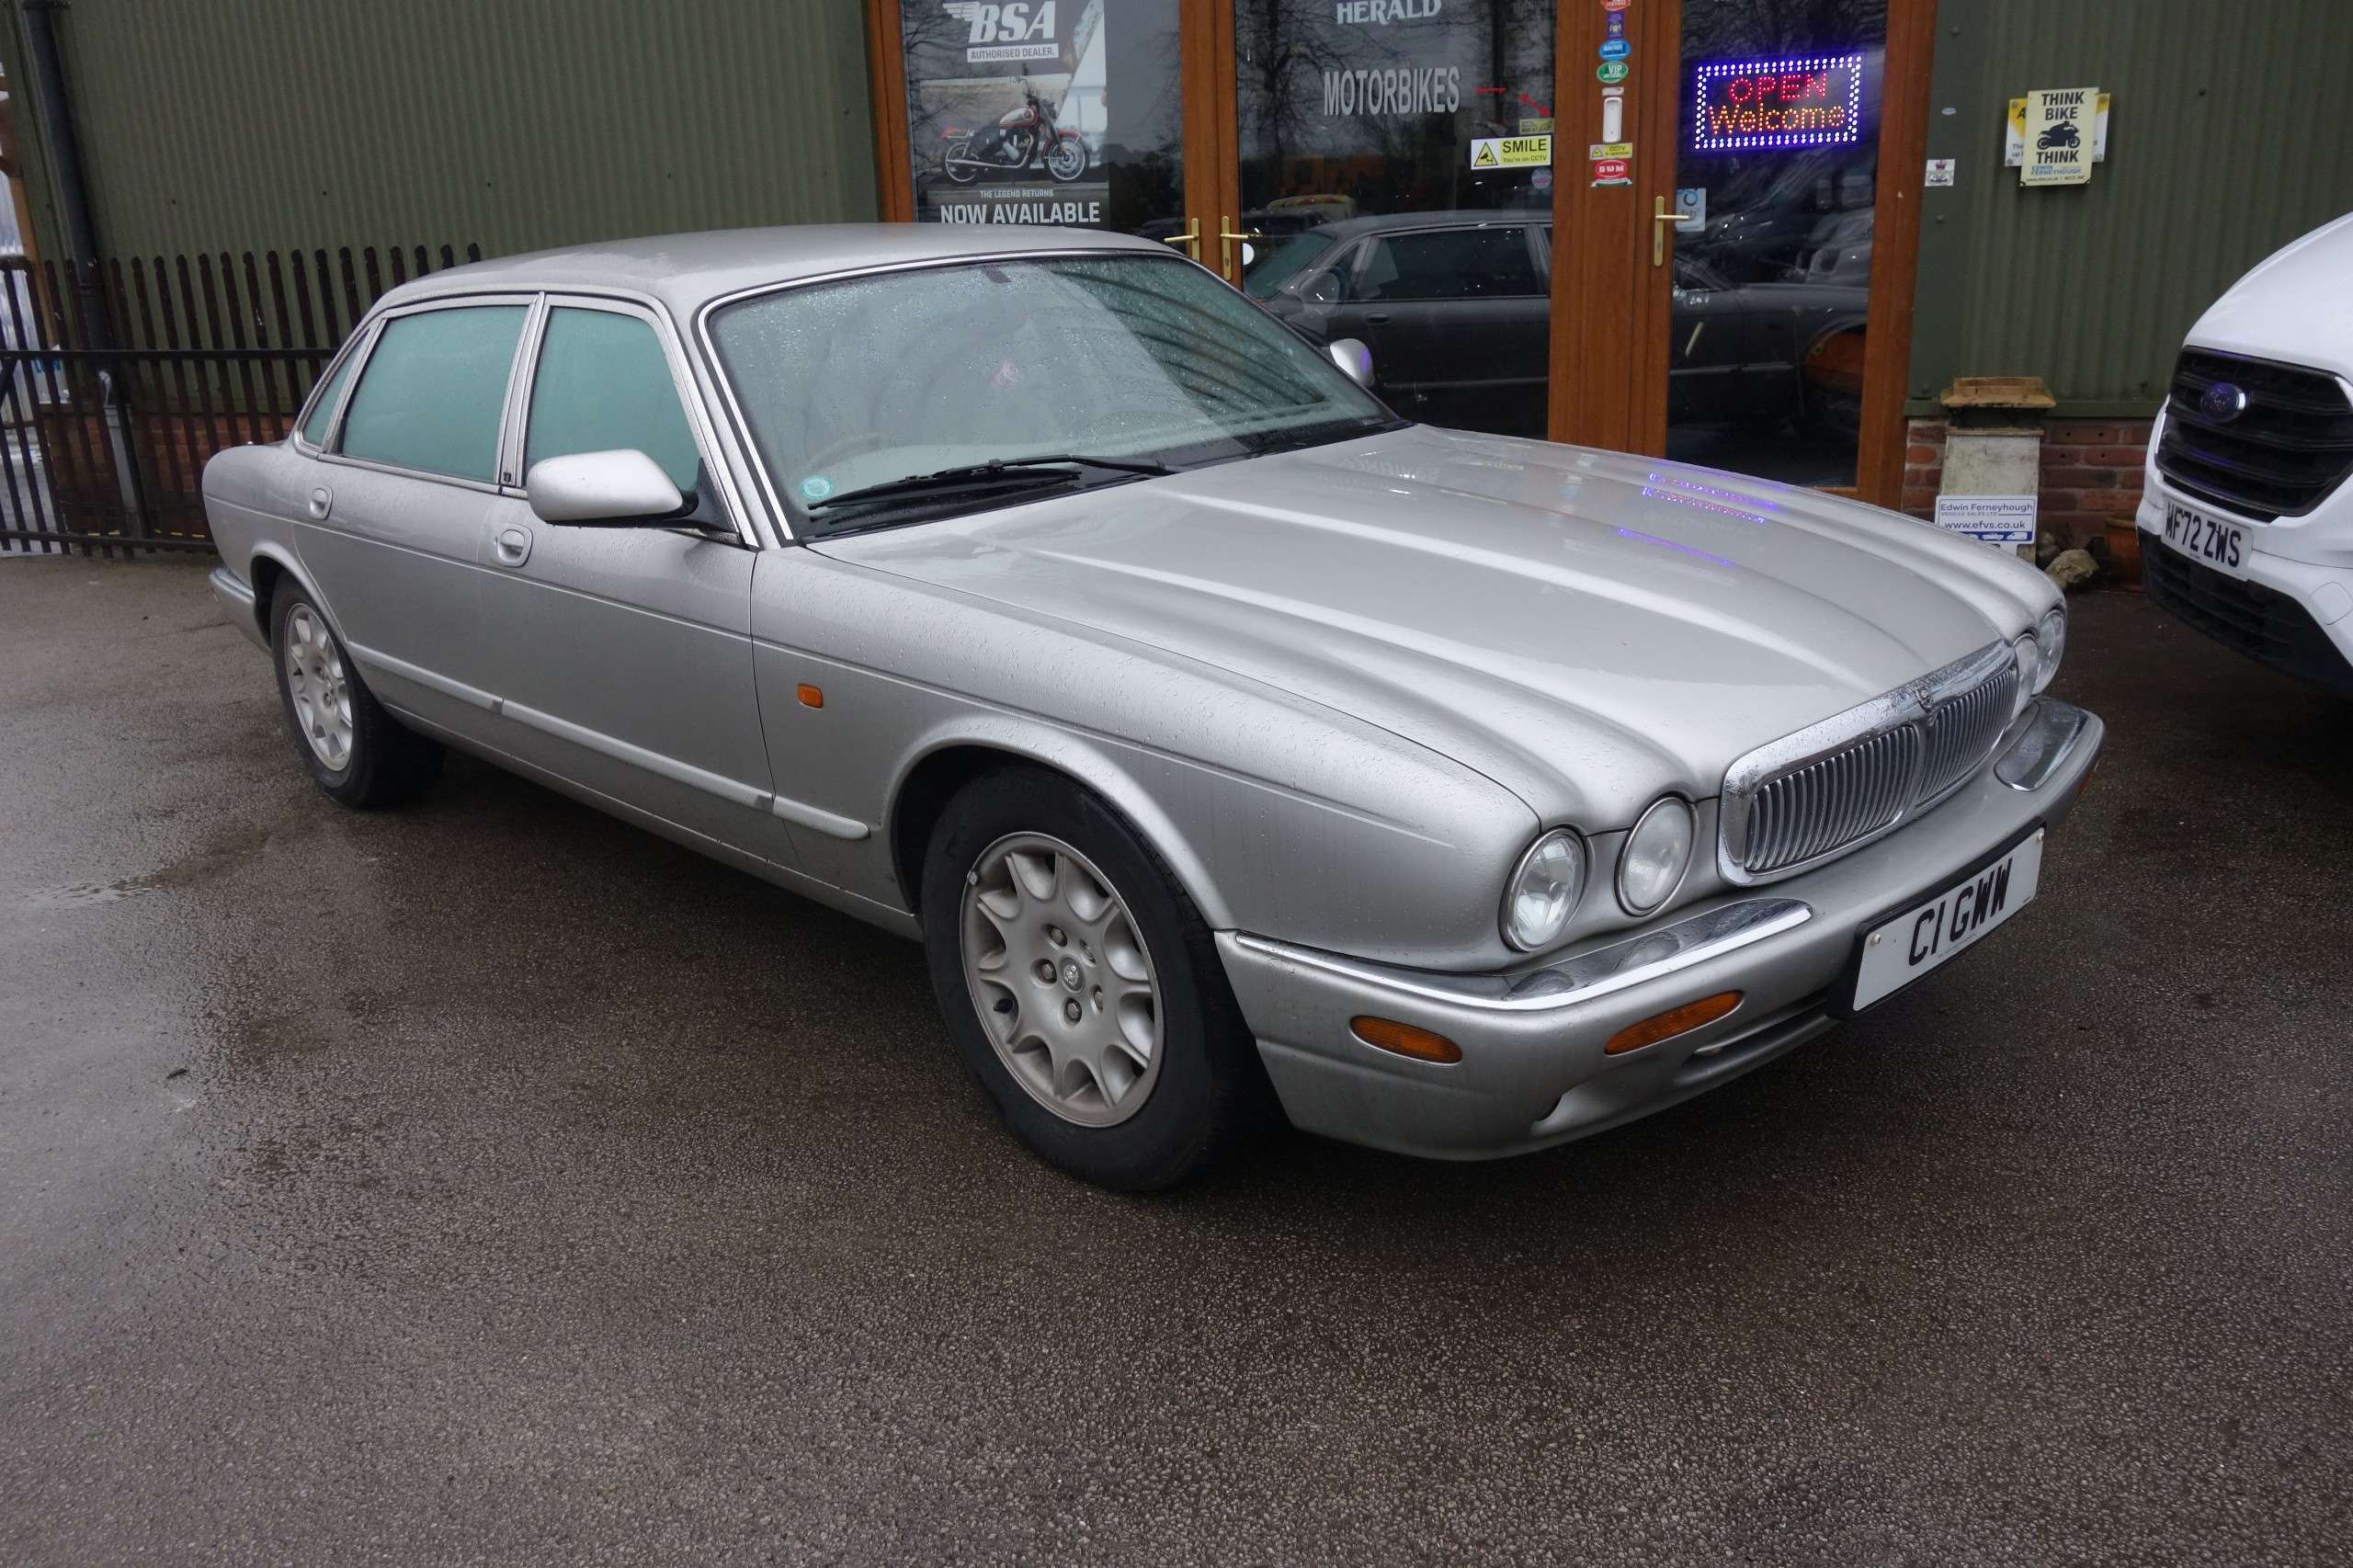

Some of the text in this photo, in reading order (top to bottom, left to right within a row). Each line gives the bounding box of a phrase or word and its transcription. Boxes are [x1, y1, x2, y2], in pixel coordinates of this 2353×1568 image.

[1336, 0, 1442, 25] HERALD
[968, 1, 1055, 43] BSA
[971, 47, 1052, 60] AUTHORISED DEALER
[1608, 64, 1622, 74] VIP
[1324, 65, 1461, 116] MOTORBIKES
[1729, 72, 1828, 102] OPEN
[2041, 91, 2085, 106] THINK
[1708, 102, 1846, 134] Welcome
[2045, 107, 2078, 120] BIKE
[1502, 138, 1548, 153] SMILE
[2036, 151, 2079, 164] THINK
[980, 188, 1054, 199] THE LEGEND RETURNS
[940, 201, 1101, 224] NOW AVAILABLE
[1940, 503, 2033, 513] Edwin Ferneyhough
[1944, 520, 2026, 529] www.efvs.co.uk
[2203, 520, 2242, 567] ZWS
[1949, 857, 2013, 942] GWW
